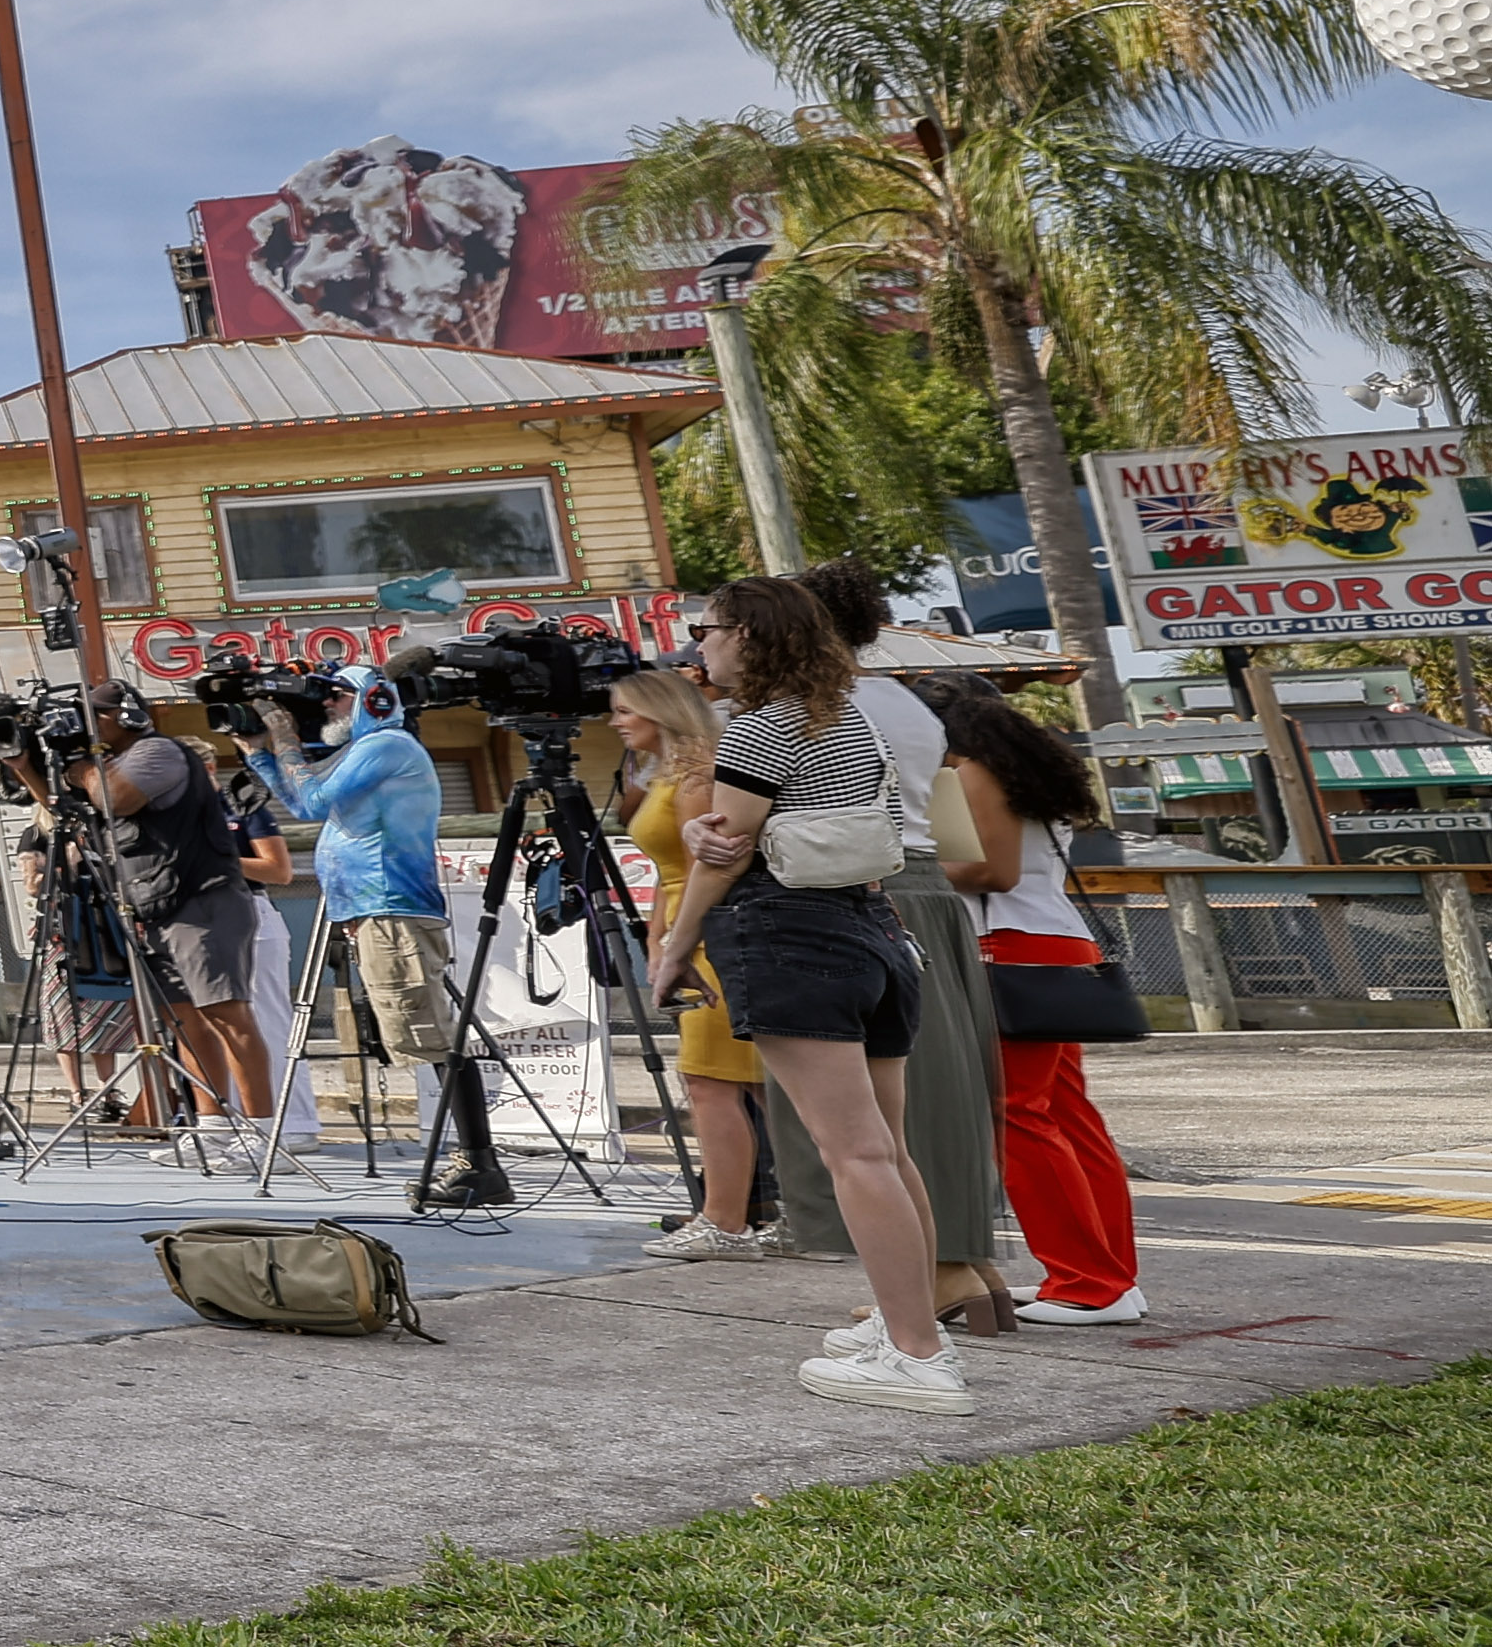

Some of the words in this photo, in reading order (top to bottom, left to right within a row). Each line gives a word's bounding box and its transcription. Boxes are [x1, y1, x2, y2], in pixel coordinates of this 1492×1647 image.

[538, 292, 589, 316] 1/2
[593, 288, 667, 310] MILE
[602, 312, 706, 335] AFTER
[1119, 450, 1330, 498] MURHY'S
[1346, 444, 1467, 482] ARMS
[1146, 577, 1393, 621] GATOR
[1170, 623, 1225, 640] MINI
[1229, 620, 1296, 637] GOLF
[1309, 616, 1369, 633] LIVE
[1373, 612, 1466, 629] SHOWS
[132, 616, 405, 681] Gator
[1369, 816, 1484, 830] GATOR
[536, 1027, 570, 1040] ALL
[531, 1044, 577, 1058] BEER
[541, 1064, 581, 1075] FOOD
